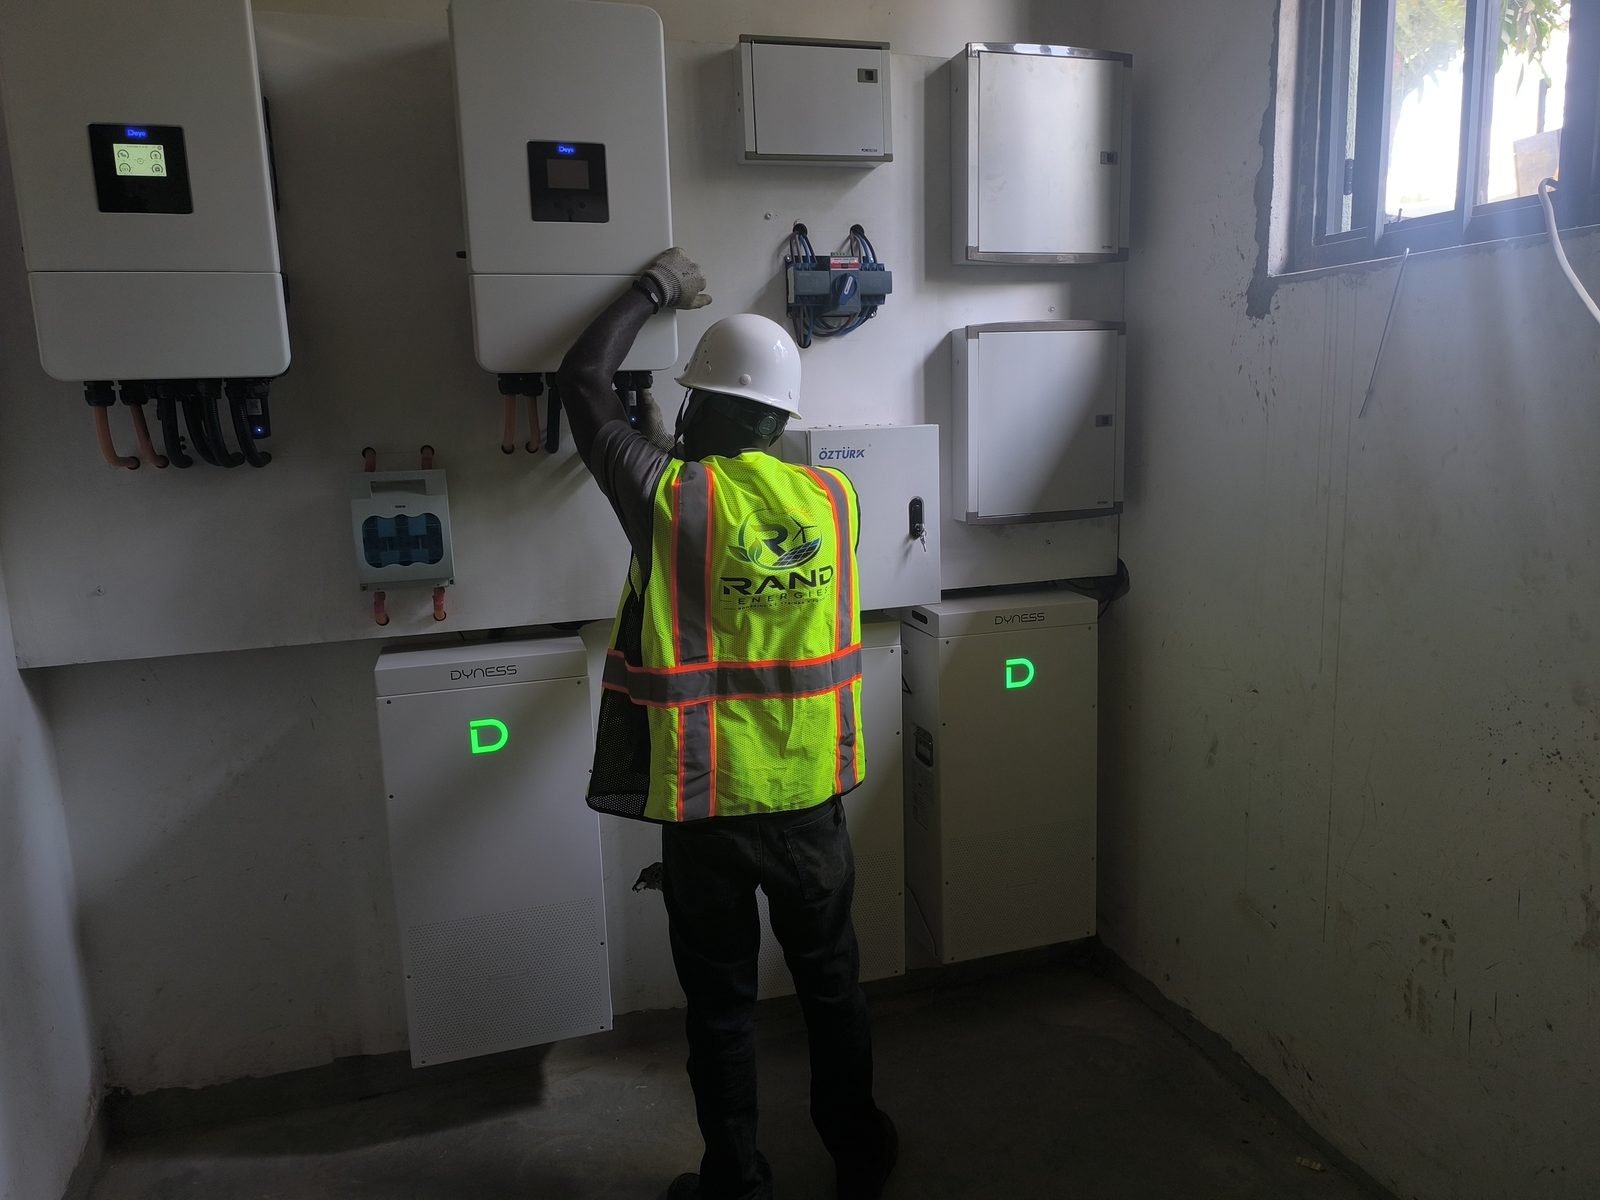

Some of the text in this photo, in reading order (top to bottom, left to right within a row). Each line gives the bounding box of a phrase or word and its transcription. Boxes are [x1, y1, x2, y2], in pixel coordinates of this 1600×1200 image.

[819, 446, 866, 460] ÖZTÜRK
[720, 565, 834, 595] RAND
[994, 612, 1046, 625] DYNESS
[450, 665, 517, 681] DYNESS
